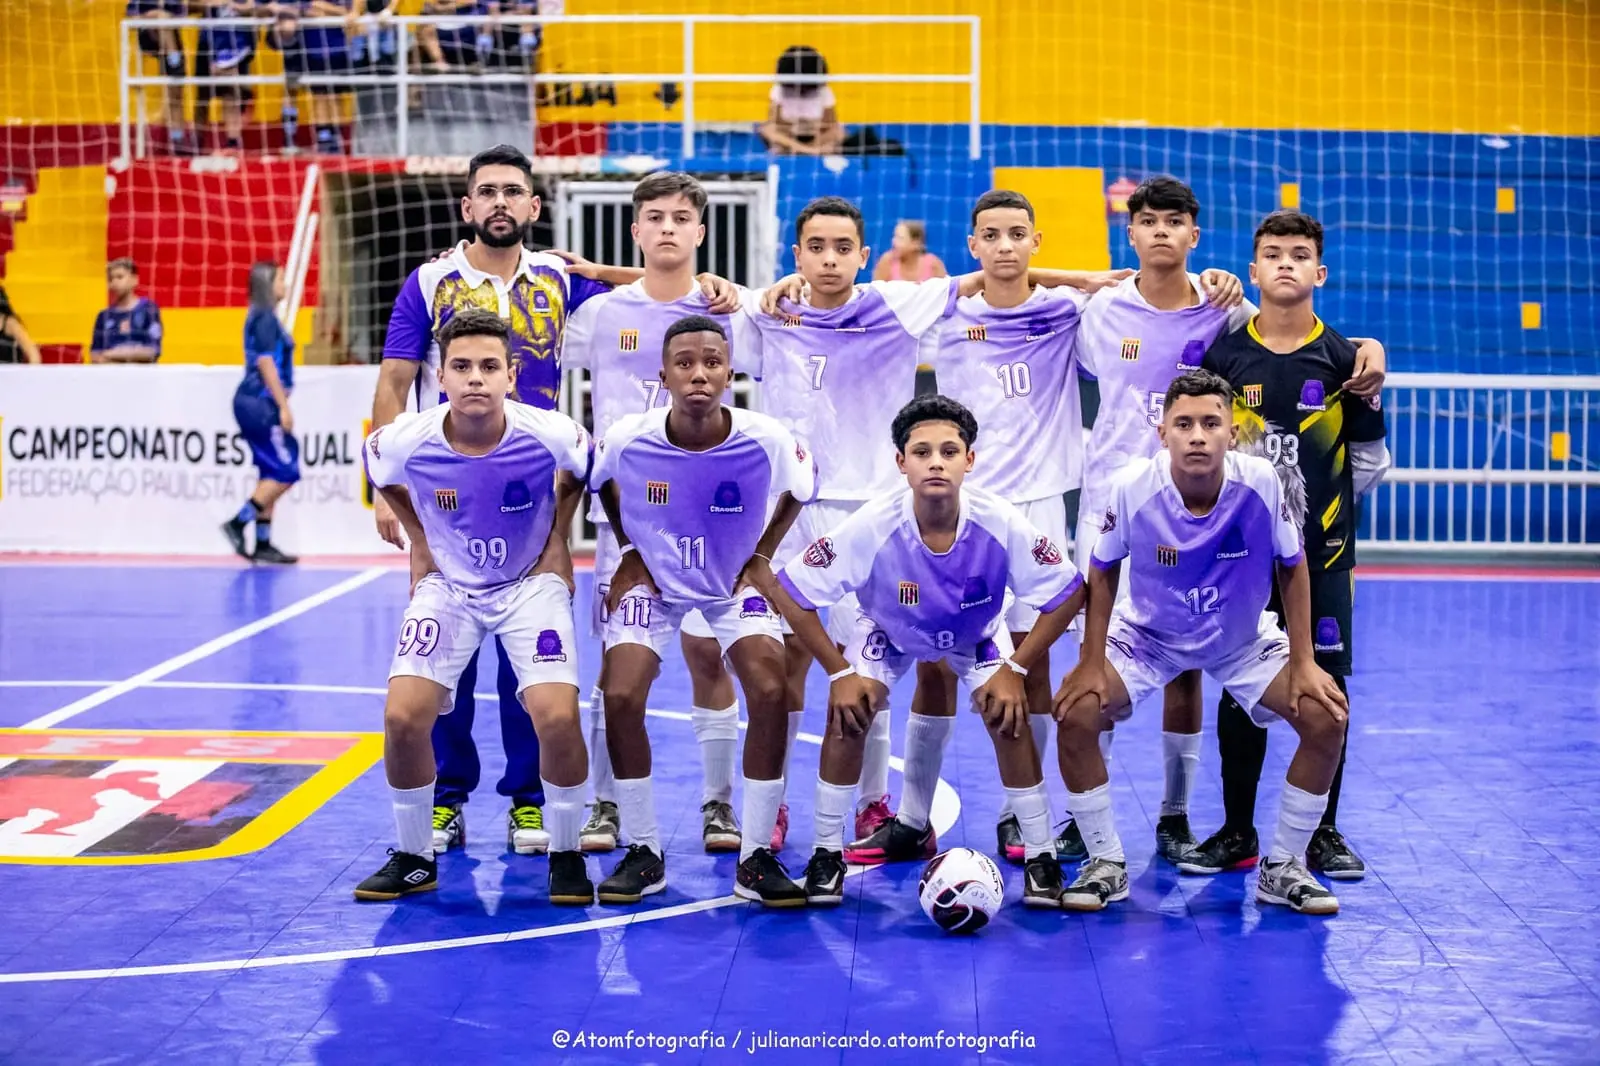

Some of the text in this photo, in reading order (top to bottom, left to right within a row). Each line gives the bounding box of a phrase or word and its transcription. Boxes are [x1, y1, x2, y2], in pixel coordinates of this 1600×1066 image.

[808, 354, 827, 390] 7
[997, 361, 1032, 399] 10
[1147, 391, 1167, 427] 5
[8, 426, 354, 467] CAMPEONATO ESUAL
[1264, 433, 1299, 467] 93
[7, 461, 137, 504] FEDERAÇÃO
[141, 469, 235, 501] PAULISTA
[289, 473, 354, 505] UTSAL
[709, 504, 744, 513] CRAQUES
[468, 536, 508, 569] 99
[677, 535, 706, 570] 11
[621, 595, 652, 628] 11
[1184, 585, 1221, 616] 12
[399, 618, 441, 657] 99
[861, 630, 889, 661] 8
[934, 628, 957, 651] 8
